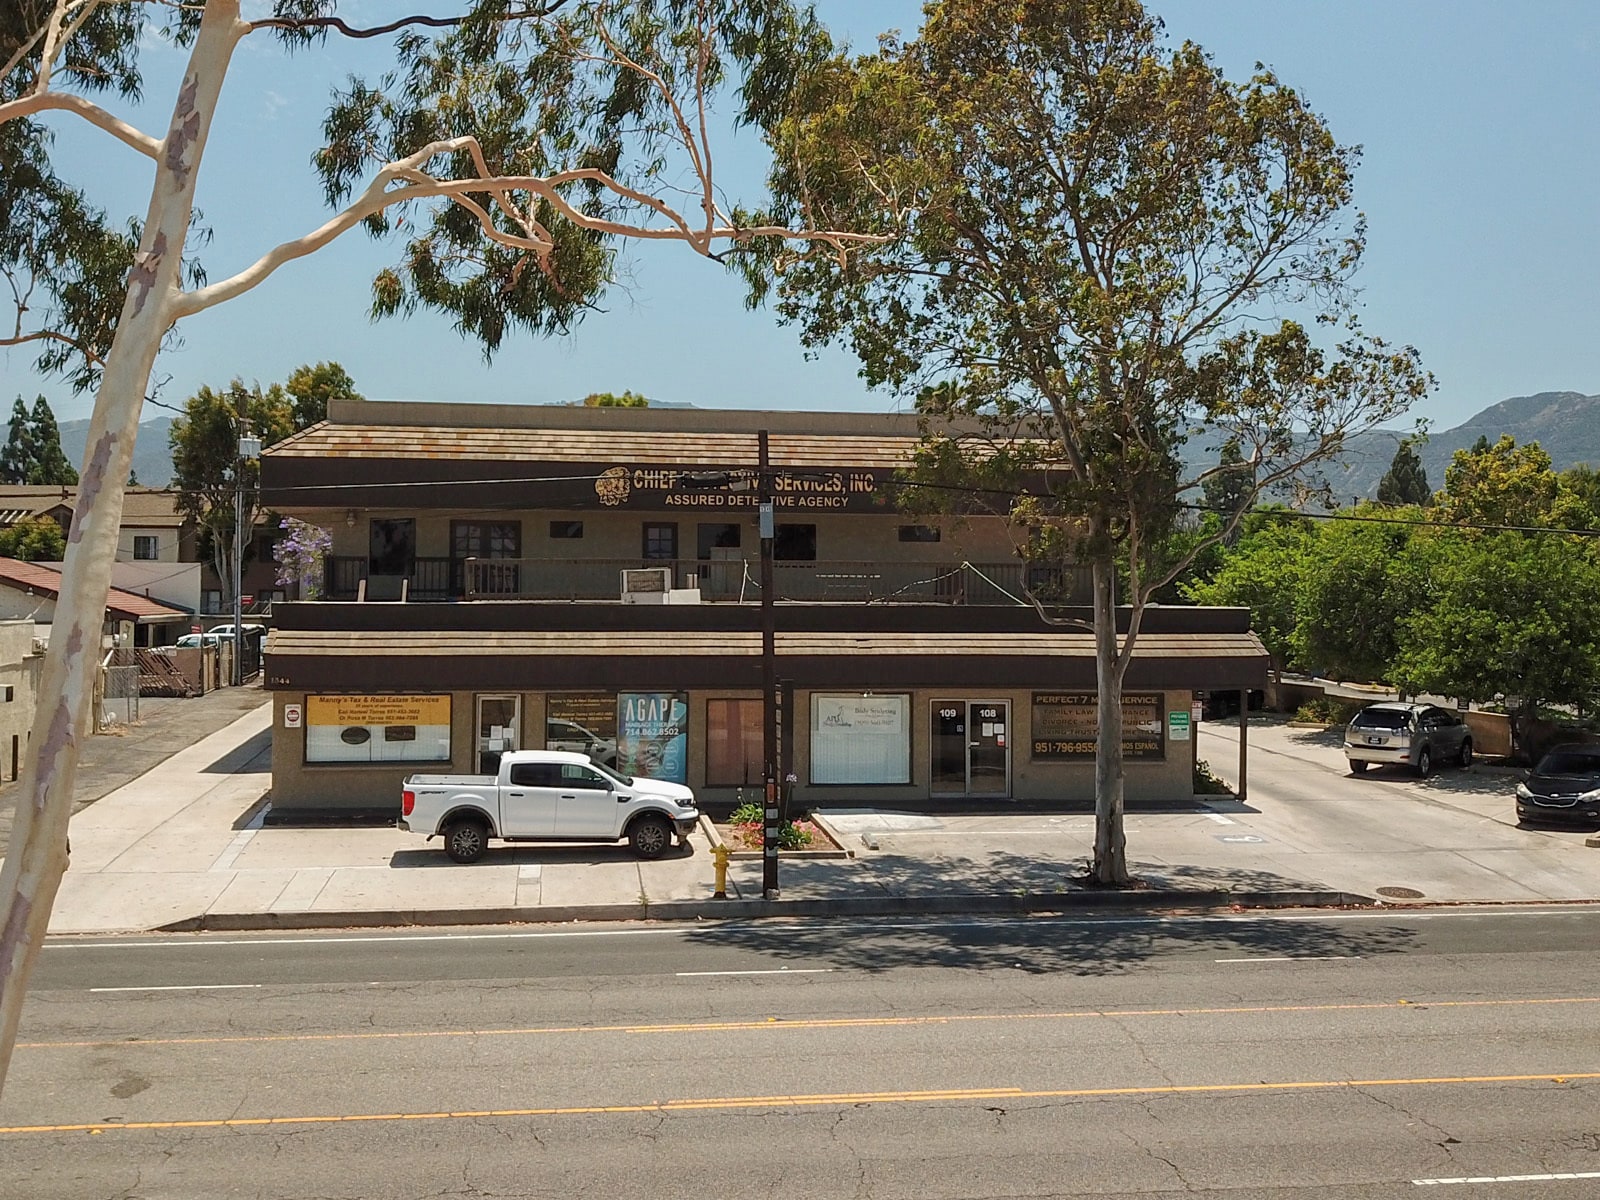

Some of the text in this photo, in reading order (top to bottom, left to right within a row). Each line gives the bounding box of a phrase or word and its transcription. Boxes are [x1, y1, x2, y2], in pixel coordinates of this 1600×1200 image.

[634, 470, 677, 489] CHIEF
[665, 495, 849, 507] ASSURED DETETIVE AGENCY
[1080, 696, 1088, 704] 7
[626, 699, 679, 721] AGAPE
[940, 709, 957, 717] 109
[980, 709, 996, 717] 108
